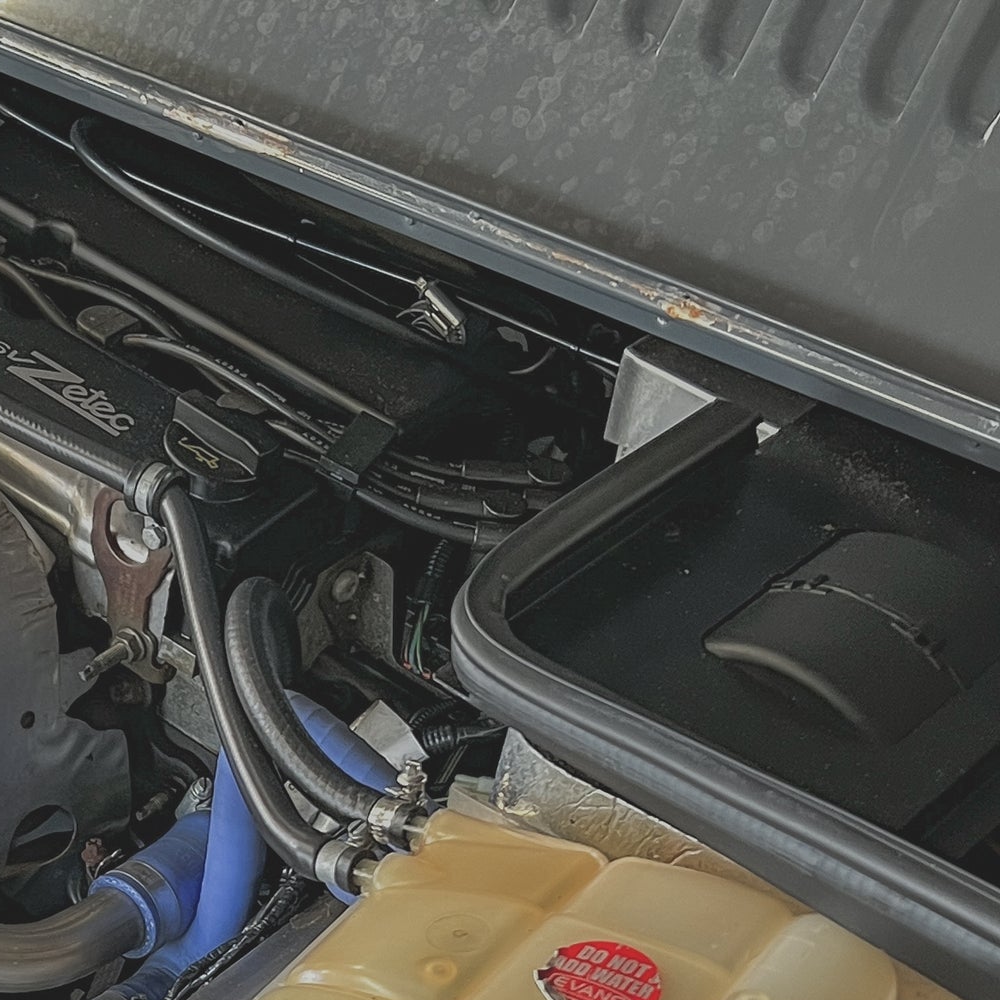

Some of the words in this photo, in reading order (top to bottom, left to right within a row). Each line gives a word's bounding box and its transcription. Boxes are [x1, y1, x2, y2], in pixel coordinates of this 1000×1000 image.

[6, 350, 135, 437] Zetec
[554, 955, 591, 976] ADD
[591, 967, 654, 1000] WATER
[576, 945, 609, 964] DO
[606, 954, 652, 978] NOT
